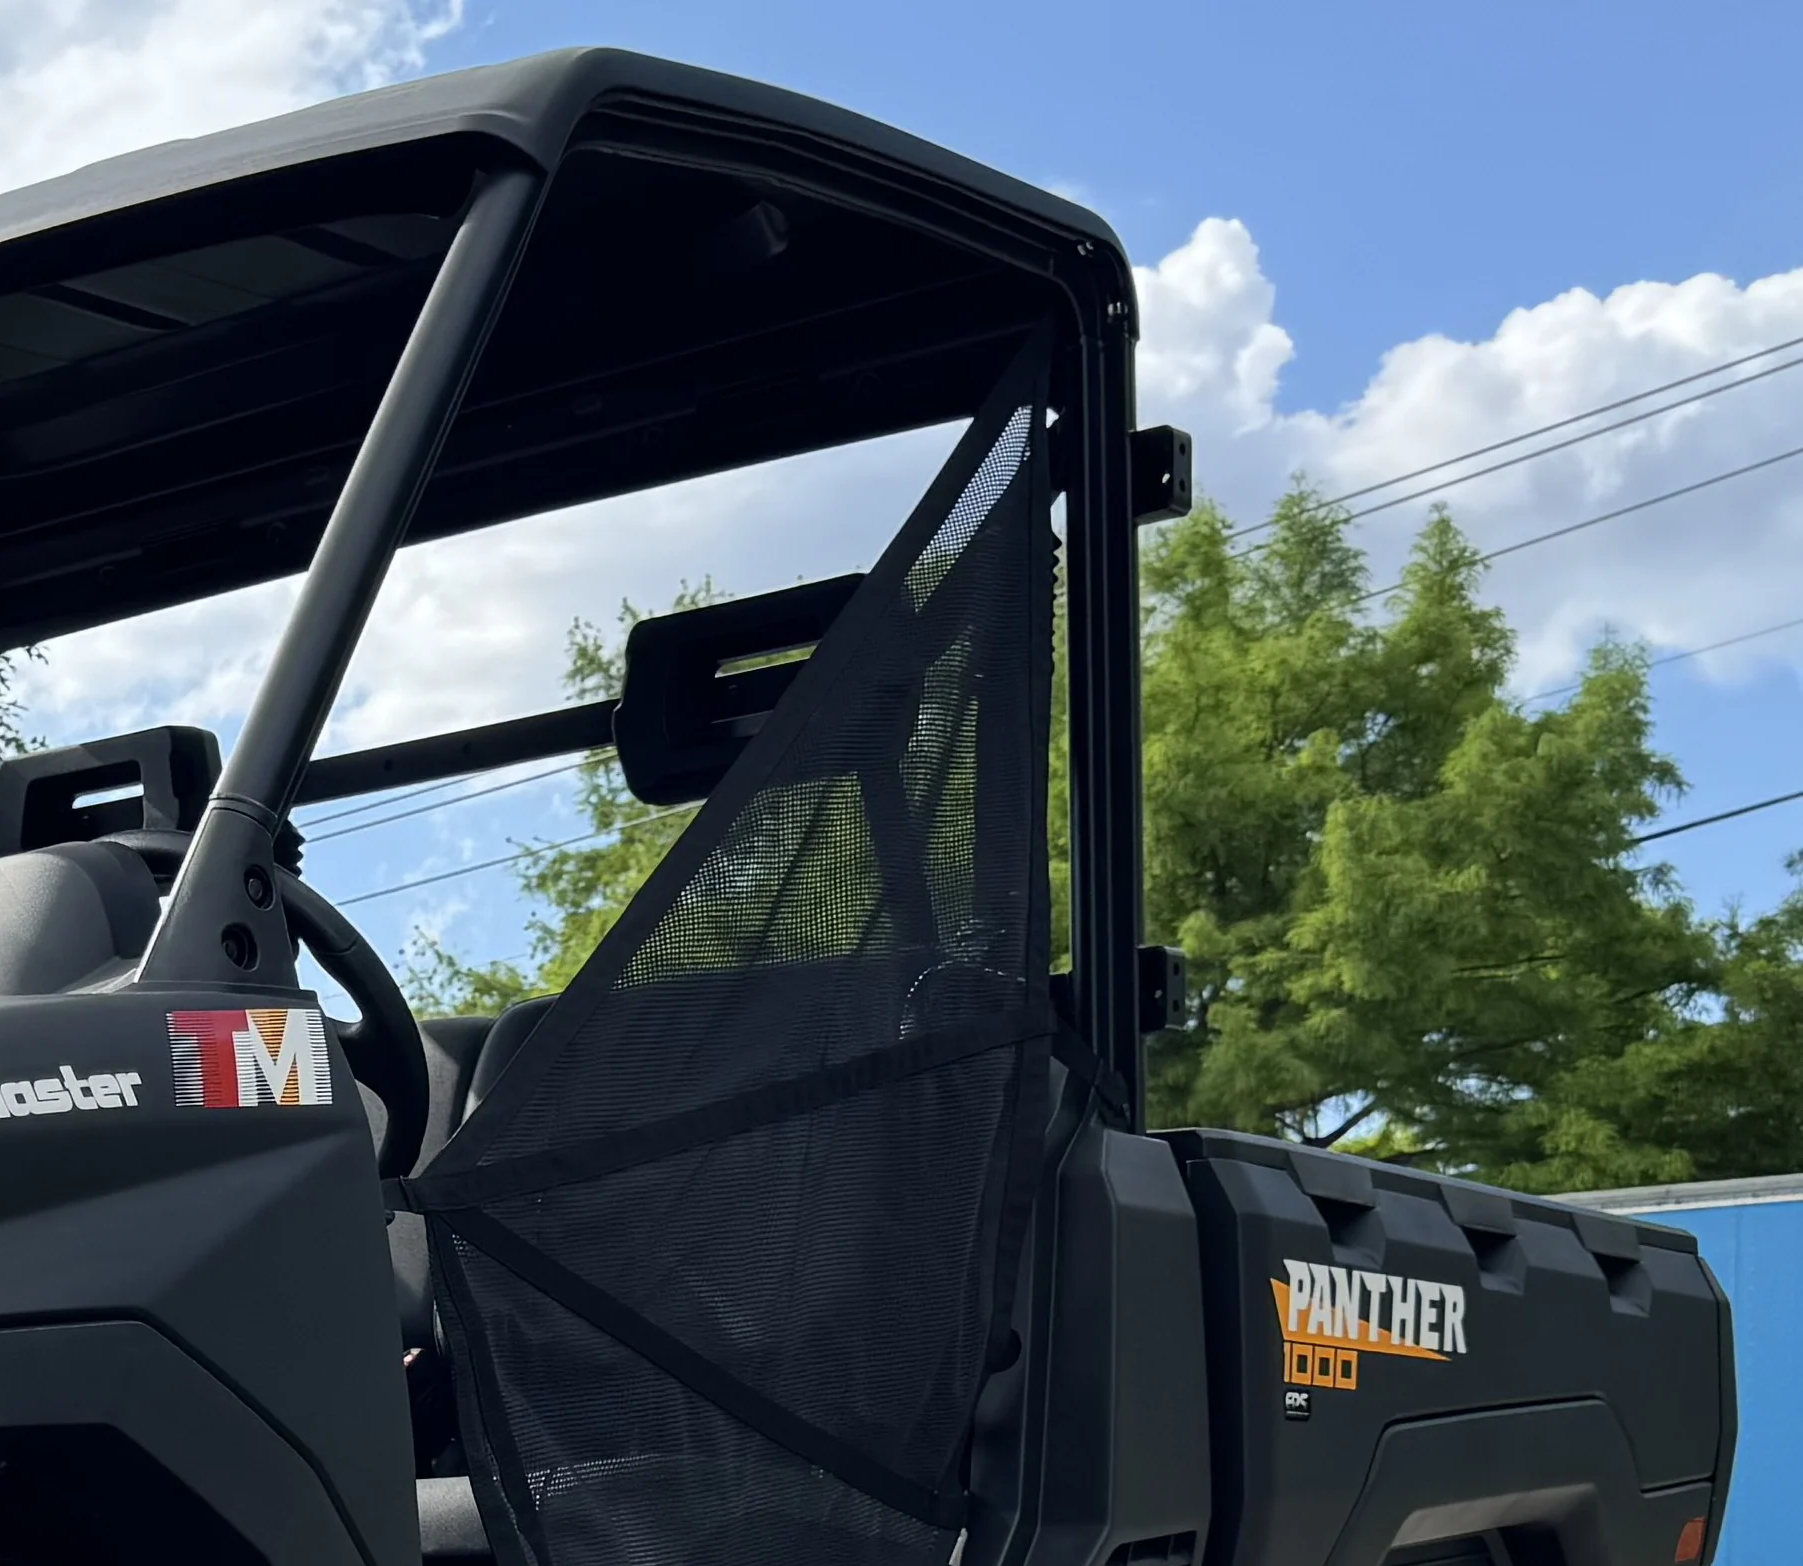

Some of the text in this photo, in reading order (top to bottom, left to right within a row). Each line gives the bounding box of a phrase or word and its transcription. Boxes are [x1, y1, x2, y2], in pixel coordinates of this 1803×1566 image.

[164, 1008, 334, 1109] TM
[1282, 1258, 1468, 1355] PANTHER
[1283, 1340, 1359, 1390] 1000
